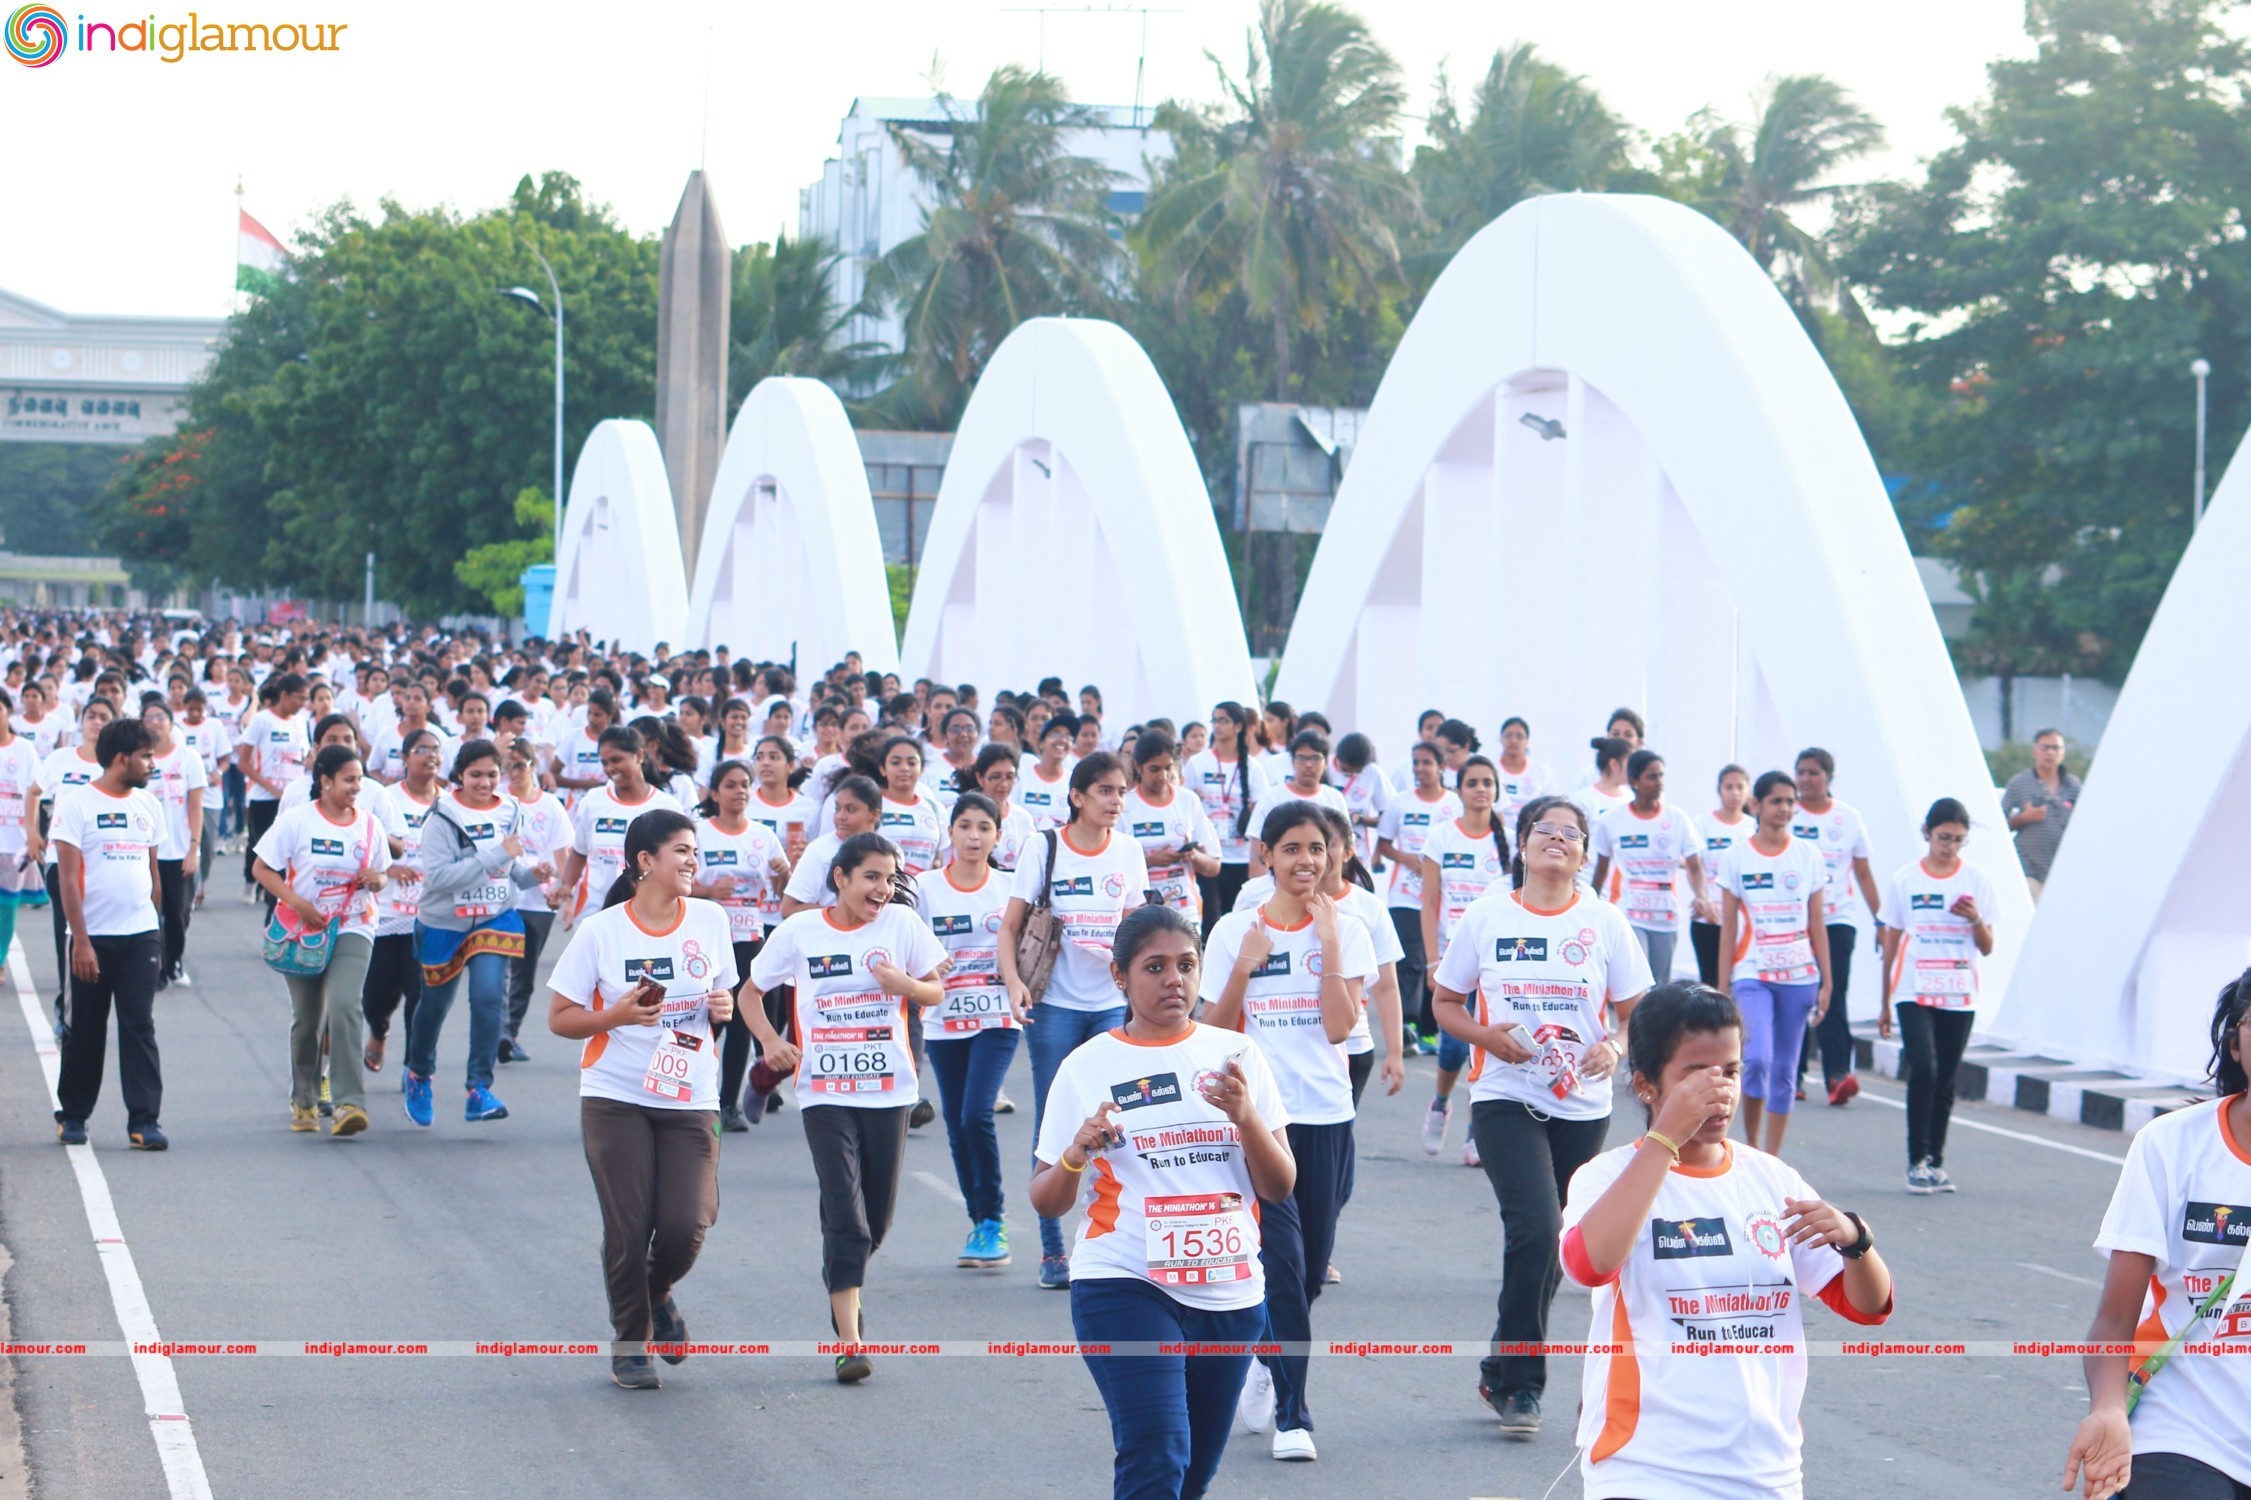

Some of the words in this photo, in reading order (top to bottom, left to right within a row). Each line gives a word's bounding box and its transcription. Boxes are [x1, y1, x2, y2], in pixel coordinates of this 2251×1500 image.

[1502, 983, 1521, 996] The
[814, 998, 833, 1010] The
[948, 994, 1004, 1014] 4501
[1247, 1001, 1267, 1013] The
[1512, 1001, 1531, 1011] Run
[1532, 1001, 1541, 1011] to
[1542, 1001, 1579, 1012] Educate
[826, 1012, 842, 1023] Run
[843, 1011, 854, 1021] to
[855, 1008, 889, 1020] Educate
[1258, 1018, 1276, 1028] Run
[1279, 1017, 1288, 1027] to
[1291, 1015, 1322, 1026] Educat
[661, 1019, 671, 1028] to
[863, 1043, 884, 1051] PKT
[819, 1052, 887, 1073] 0168
[1117, 1090, 1143, 1106] பெண்
[1151, 1084, 1177, 1098] கல்வி
[1132, 1134, 1157, 1151] The
[1151, 1156, 1171, 1169] Run
[1174, 1155, 1186, 1167] to
[1148, 1204, 1163, 1213] THE
[1214, 1216, 1234, 1227] PKF
[2186, 1218, 2215, 1234] பெண்
[1161, 1226, 1241, 1258] 1536
[1658, 1235, 1686, 1249] பெண்
[1164, 1259, 1185, 1267] RUN
[1187, 1258, 1198, 1266] TO
[1200, 1256, 1235, 1265] EDUCATE
[2183, 1274, 2212, 1294] The
[1668, 1297, 1700, 1316] The
[1686, 1325, 1716, 1341] Run
[1722, 1325, 1732, 1341] to
[1731, 1323, 1776, 1340] Educat
